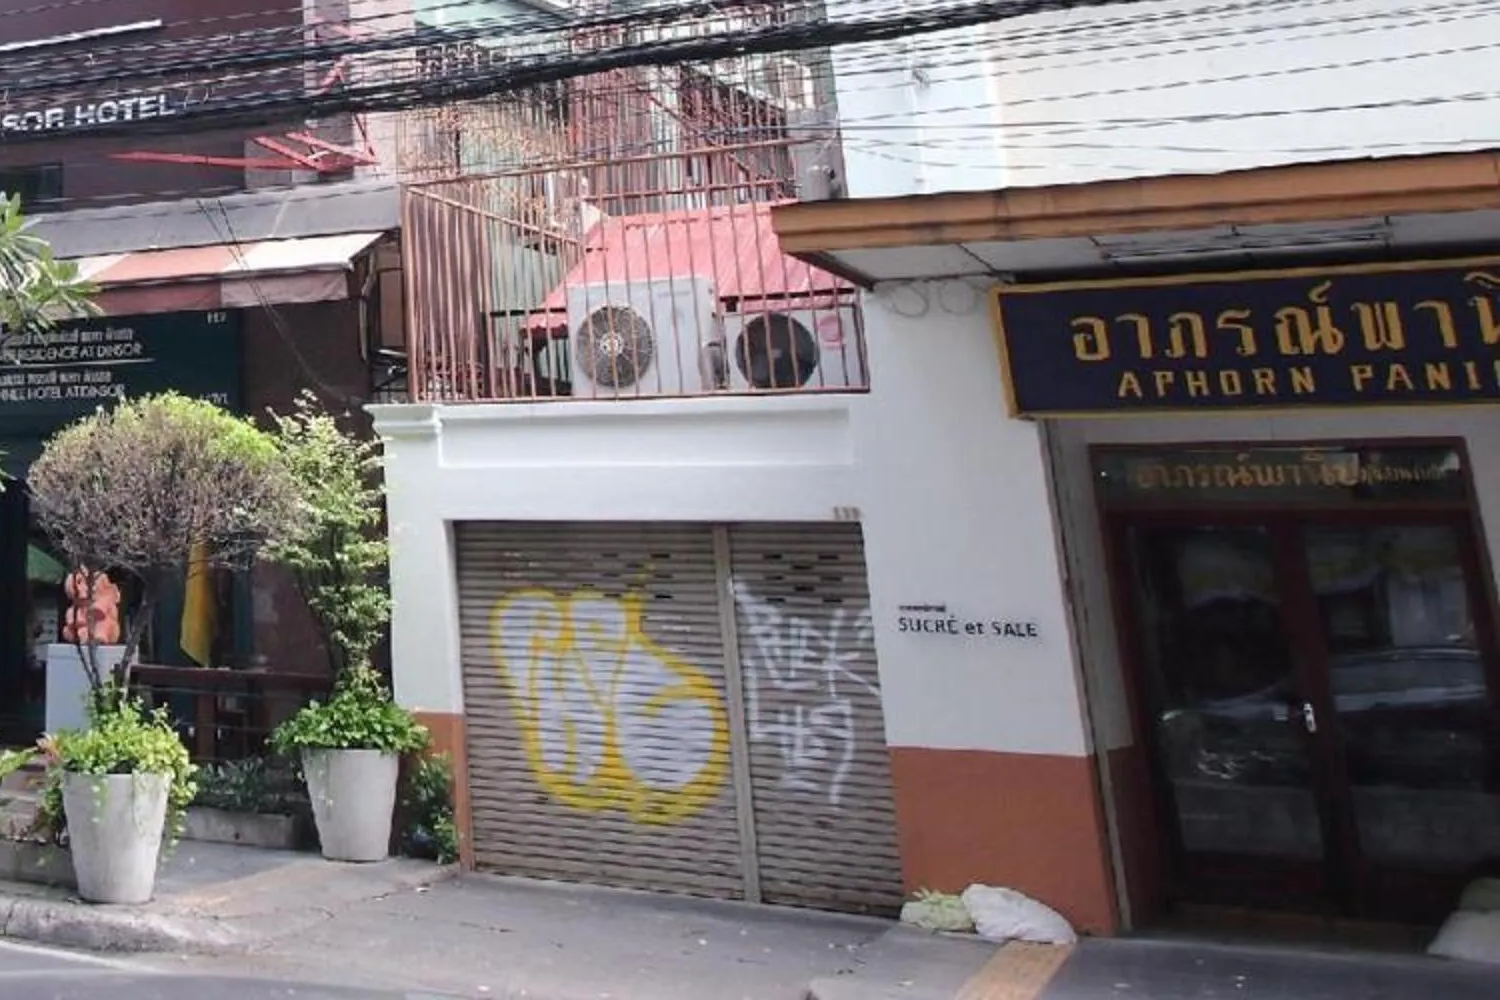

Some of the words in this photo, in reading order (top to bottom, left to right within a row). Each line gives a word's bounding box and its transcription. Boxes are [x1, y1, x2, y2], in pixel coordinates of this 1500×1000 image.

[73, 93, 177, 126] HOTEL
[1117, 365, 1317, 399] APHORN
[1350, 359, 1500, 392] PANI
[26, 385, 63, 400] HOTEL
[964, 621, 985, 636] et
[990, 620, 1039, 638] SALE
